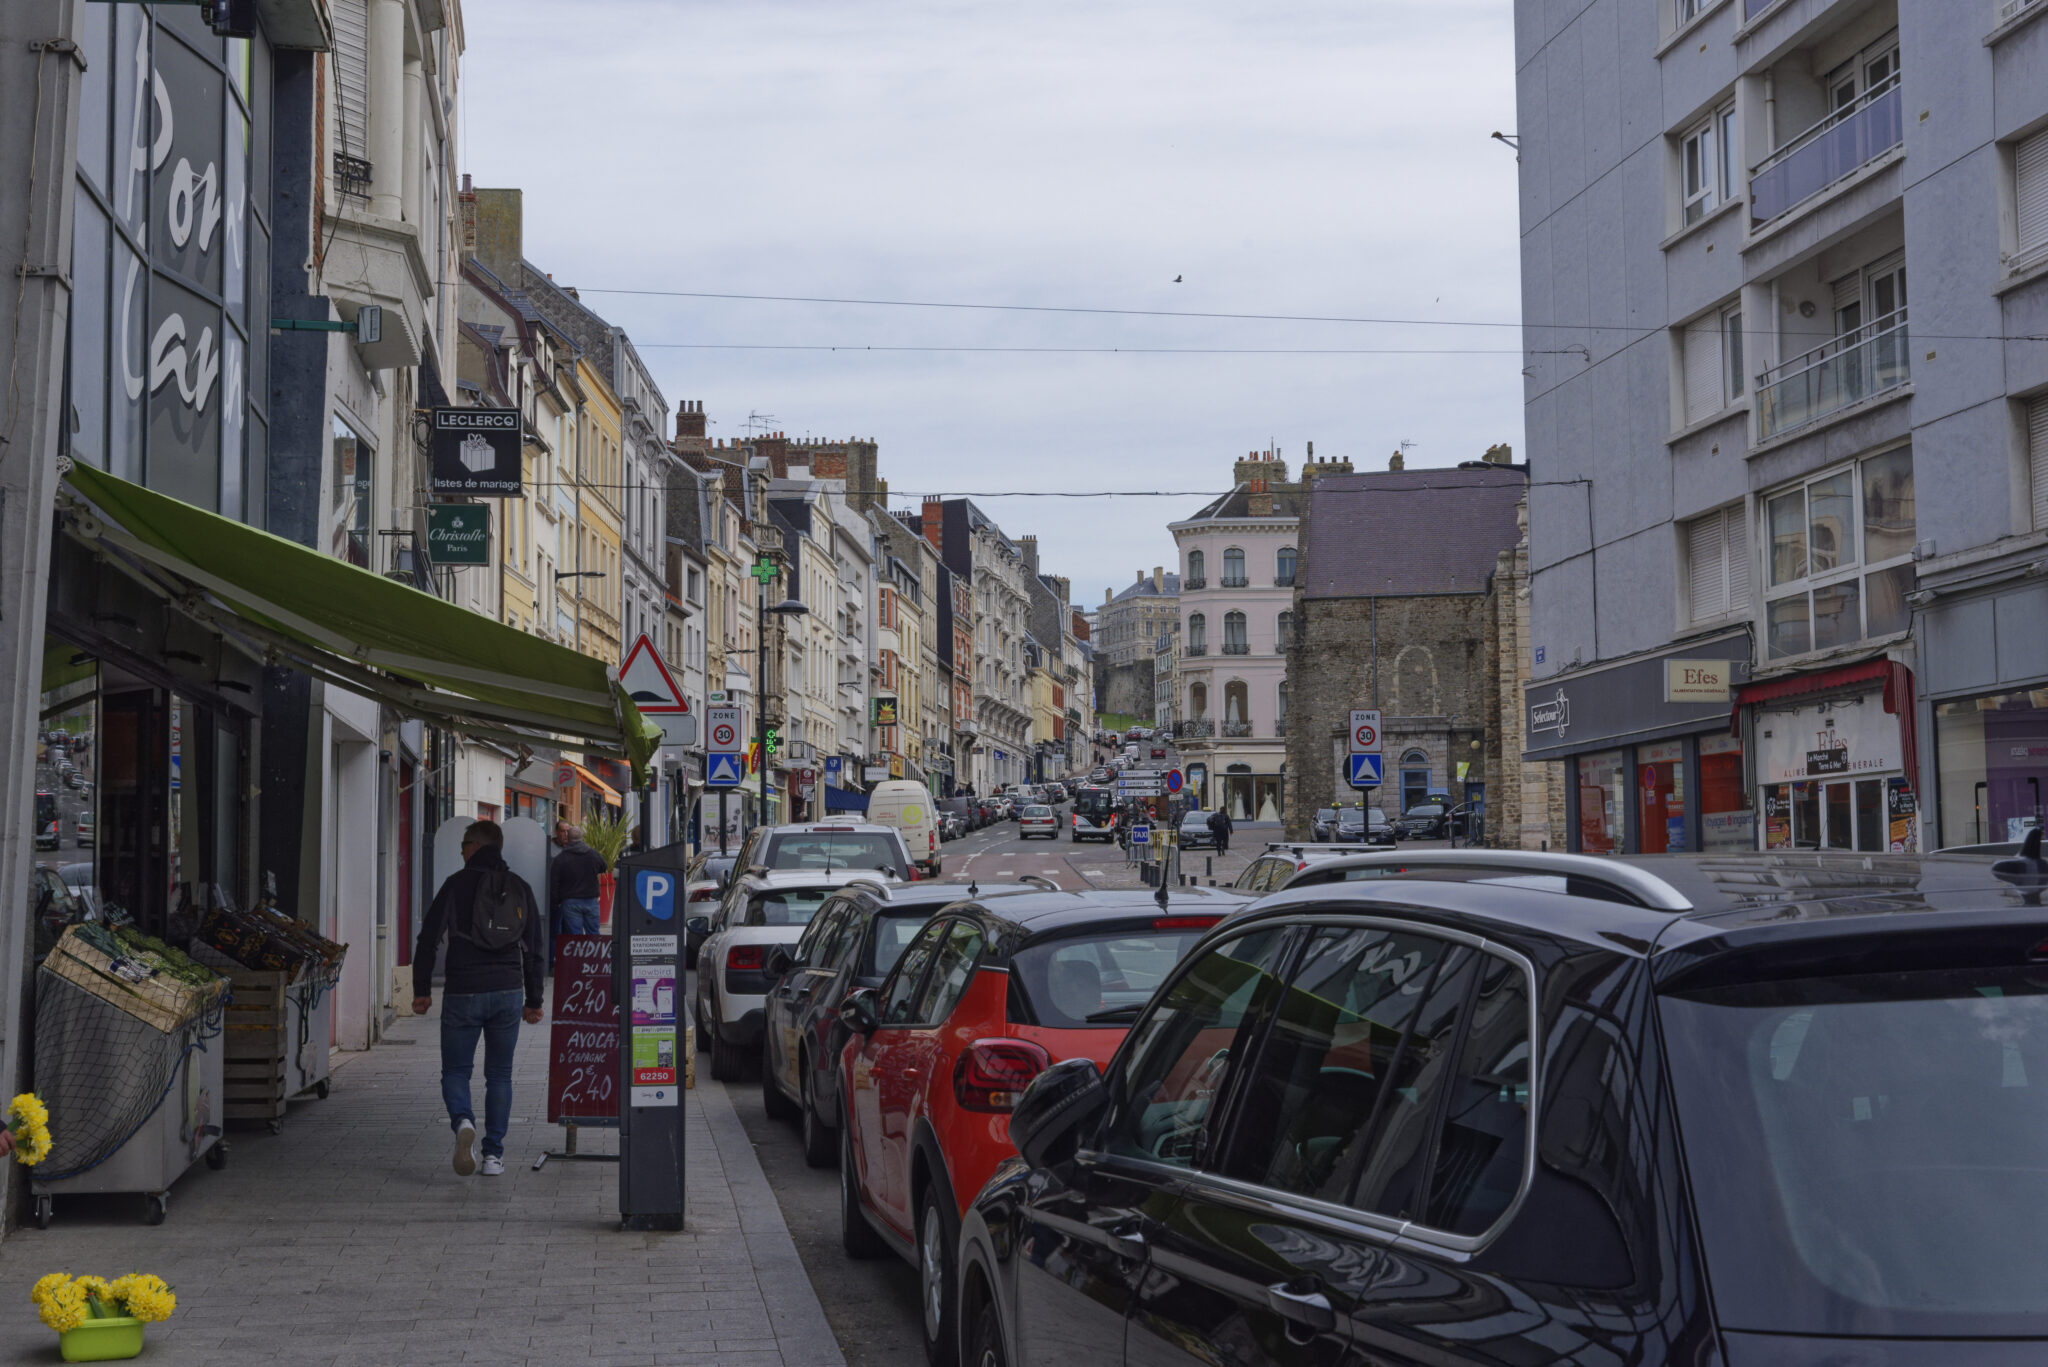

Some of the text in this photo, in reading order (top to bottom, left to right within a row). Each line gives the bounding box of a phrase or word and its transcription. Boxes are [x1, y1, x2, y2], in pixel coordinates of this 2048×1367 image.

[441, 414, 514, 426] LECLERCQ
[434, 478, 520, 491] listes de mariage
[430, 528, 486, 541] Christofle
[447, 544, 468, 552] Paris
[1683, 668, 1718, 685] Efes
[712, 712, 736, 720] ZONE
[1355, 713, 1376, 721] ZONE
[717, 730, 731, 740] 30
[1360, 730, 1372, 741] 30
[1133, 831, 1148, 839] TAXI
[646, 875, 669, 910] P
[582, 962, 598, 974] DU
[640, 1072, 669, 1081] 62250
